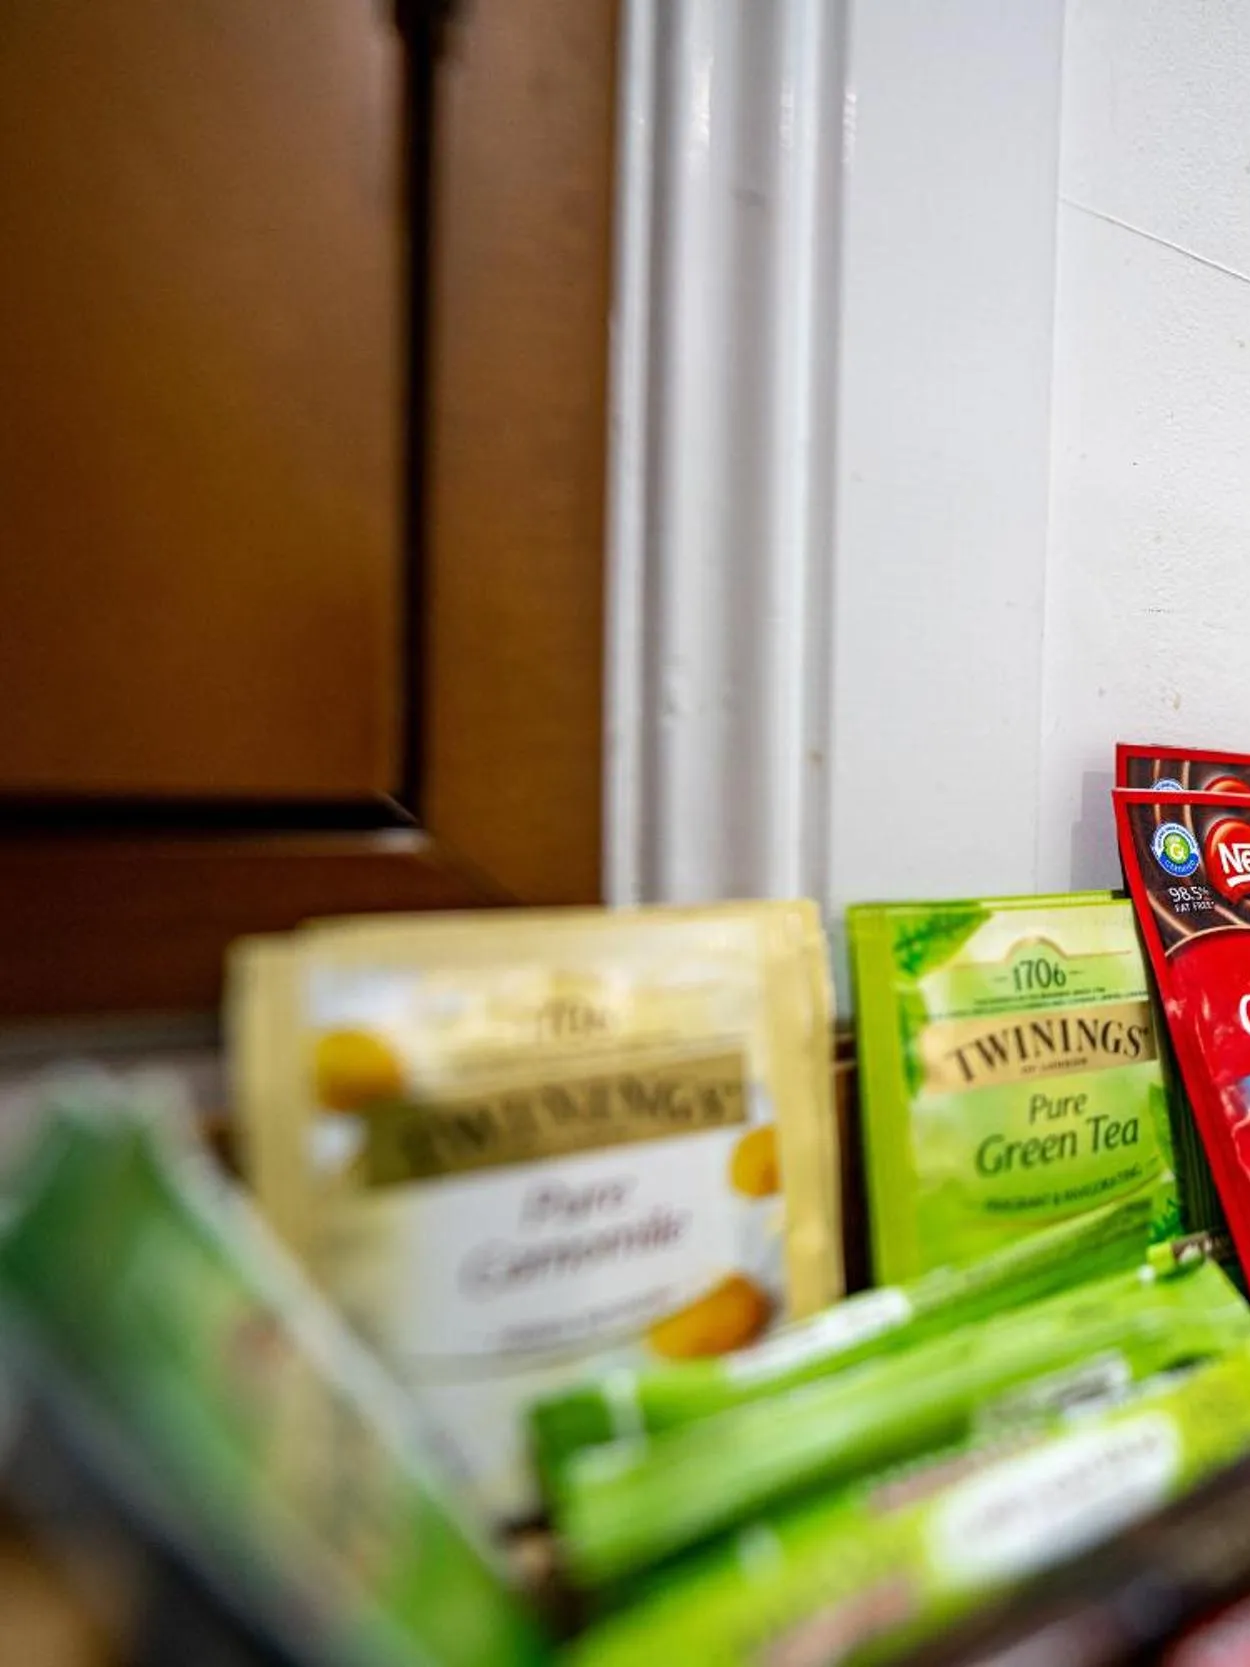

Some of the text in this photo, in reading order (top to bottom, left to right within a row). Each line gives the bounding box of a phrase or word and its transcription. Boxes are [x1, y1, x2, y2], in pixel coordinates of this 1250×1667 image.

[1168, 886, 1209, 903] 98.5%
[1013, 958, 1067, 991] 1706
[945, 1016, 1149, 1083] TWININGS
[1028, 1092, 1087, 1125] Pure
[976, 1113, 1139, 1179] Green Tea
